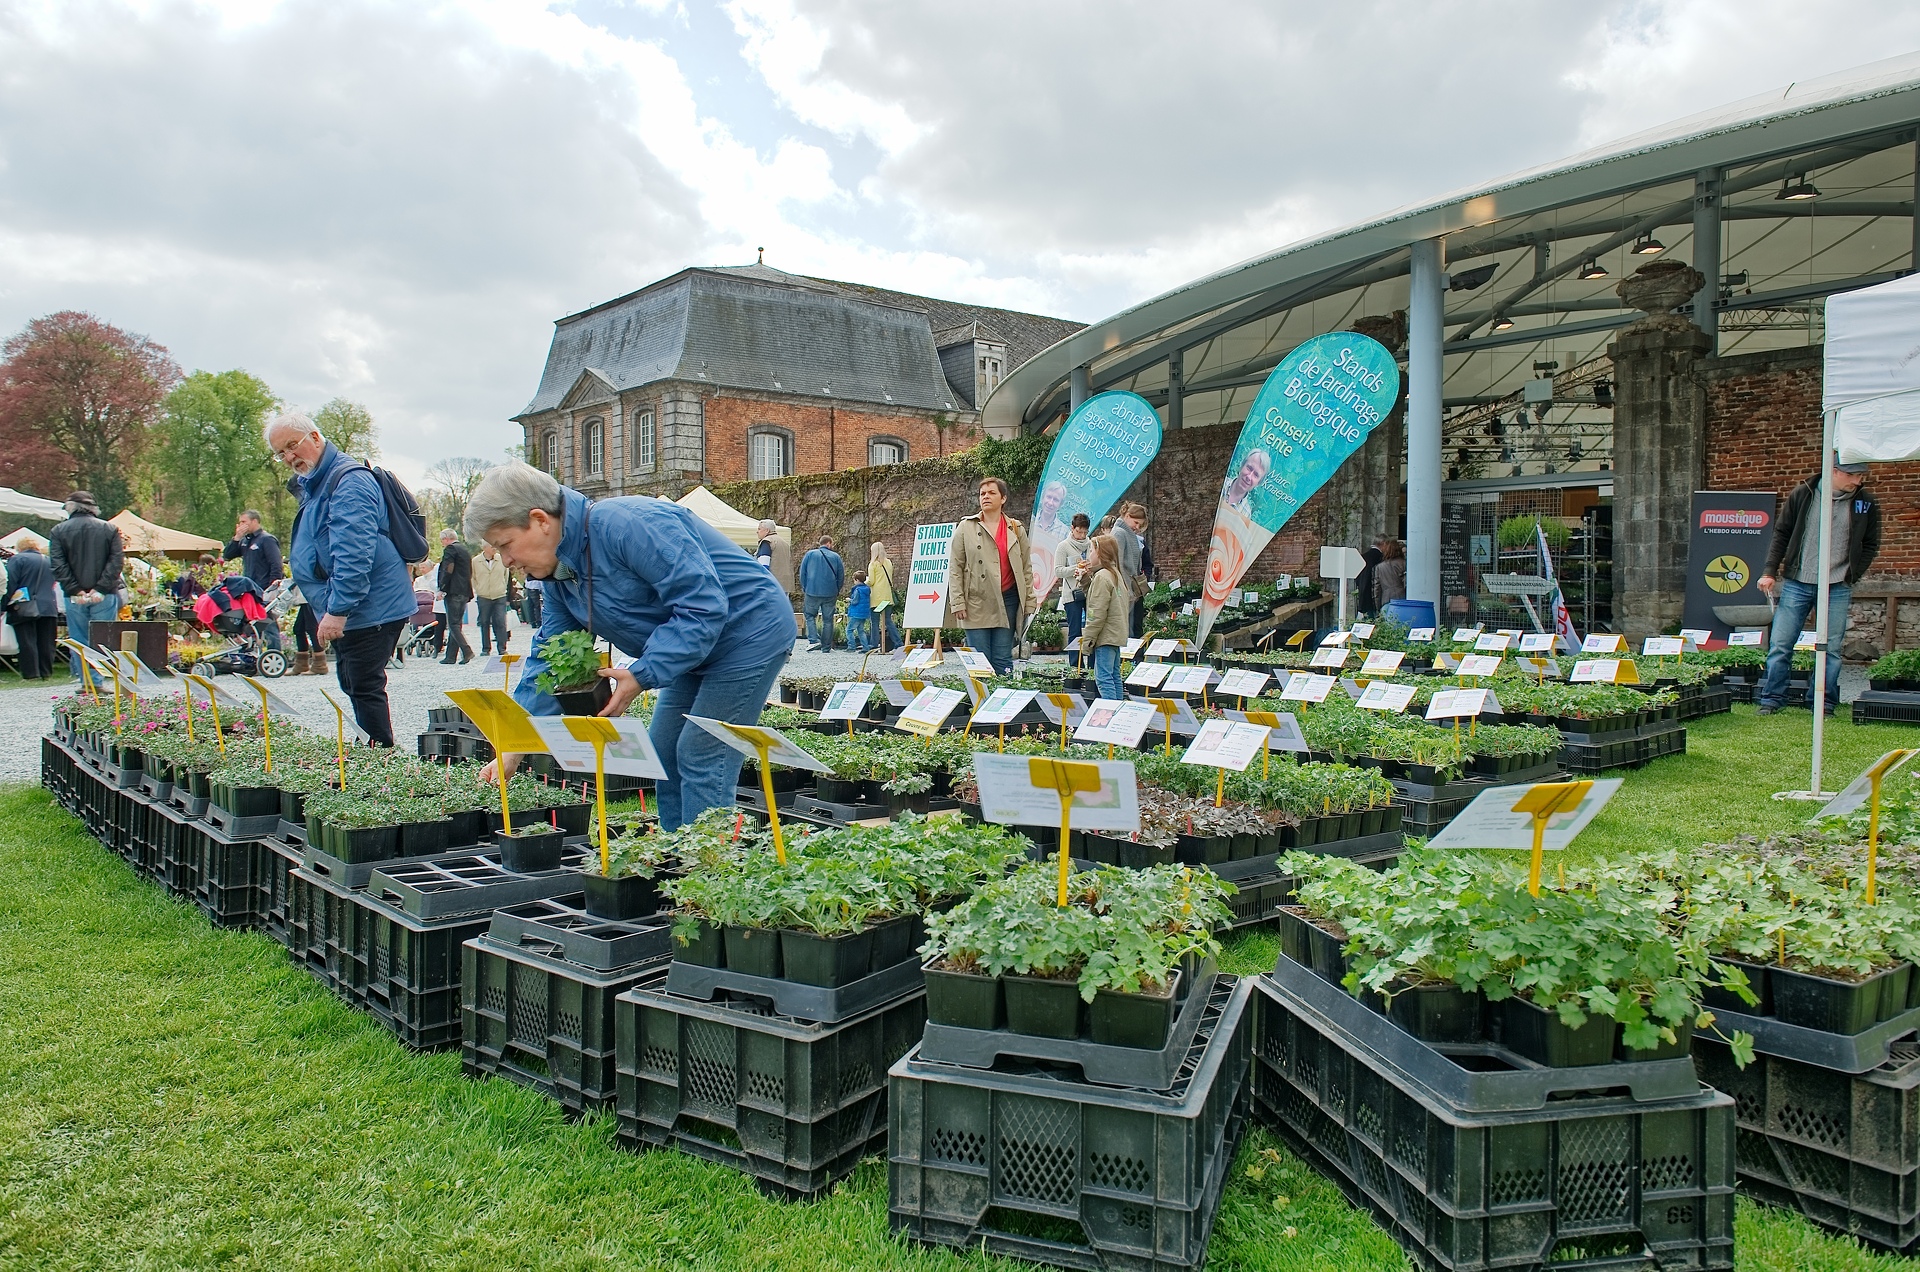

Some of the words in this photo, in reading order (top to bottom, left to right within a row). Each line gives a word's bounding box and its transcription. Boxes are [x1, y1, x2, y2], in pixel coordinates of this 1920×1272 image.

[1332, 347, 1384, 393] Stands
[1297, 357, 1320, 380] de
[1314, 368, 1380, 426] Jardinage
[1284, 378, 1360, 443] Biologique
[1259, 423, 1294, 458] Vente
[1265, 406, 1317, 452] Conseils
[1268, 469, 1290, 489] Marc
[1261, 479, 1298, 507] Knaepen
[917, 524, 953, 540] STANDS
[1705, 513, 1762, 528] moustique
[920, 541, 947, 556] VENTE
[913, 558, 949, 571] PRODUITS
[913, 572, 944, 584] NATUREL
